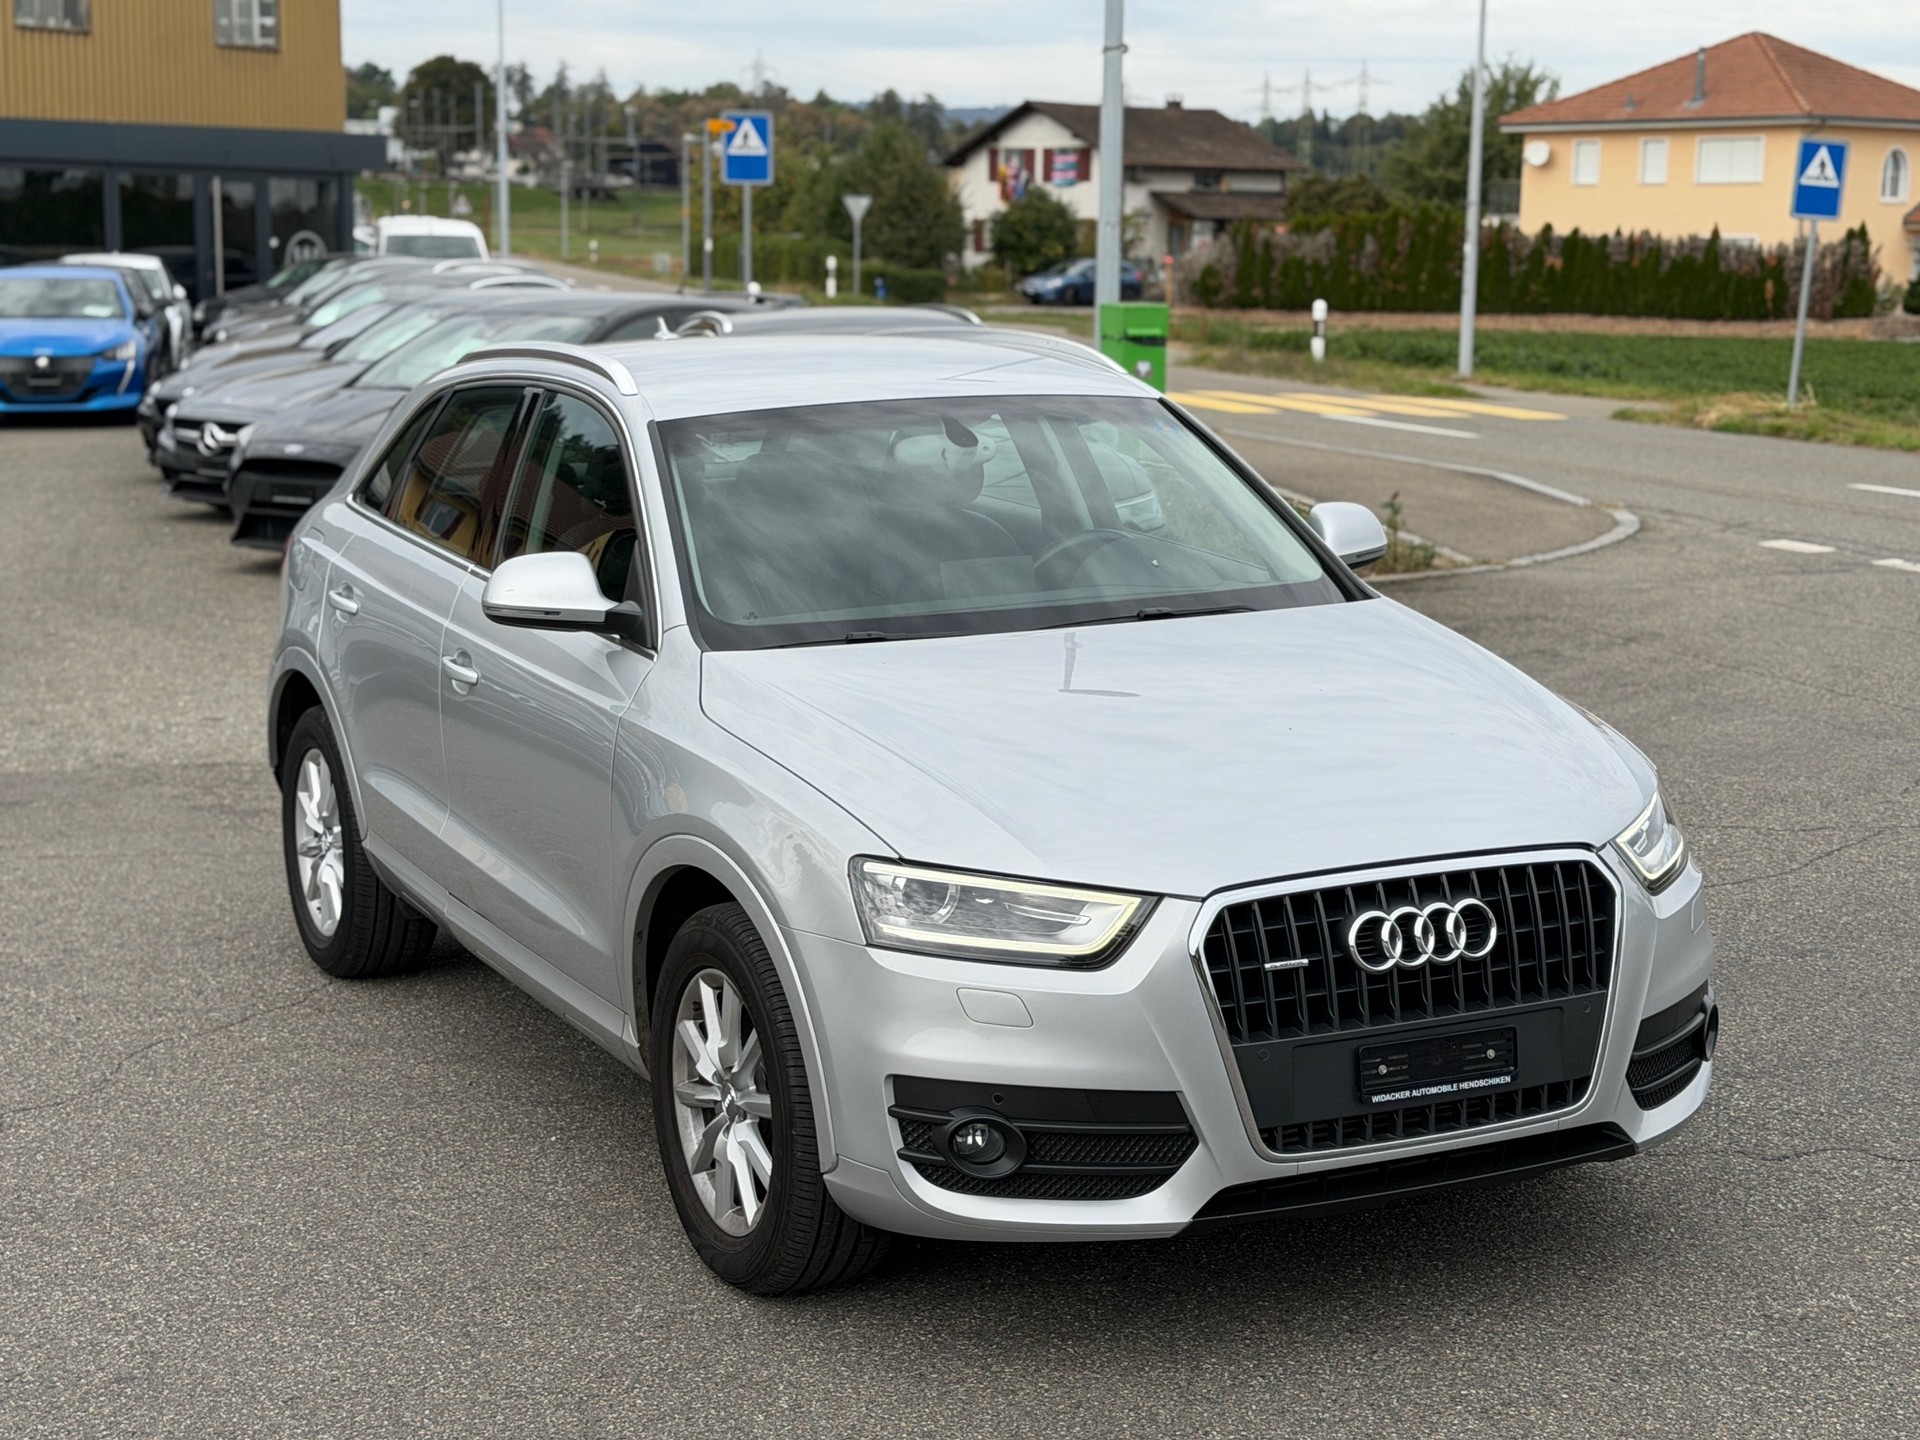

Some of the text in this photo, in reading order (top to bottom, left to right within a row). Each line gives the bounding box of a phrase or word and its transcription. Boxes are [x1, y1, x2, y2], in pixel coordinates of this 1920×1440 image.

[1371, 1075, 1511, 1103] WIDACKER AUTOMOBILE HENDSCHIKEN
